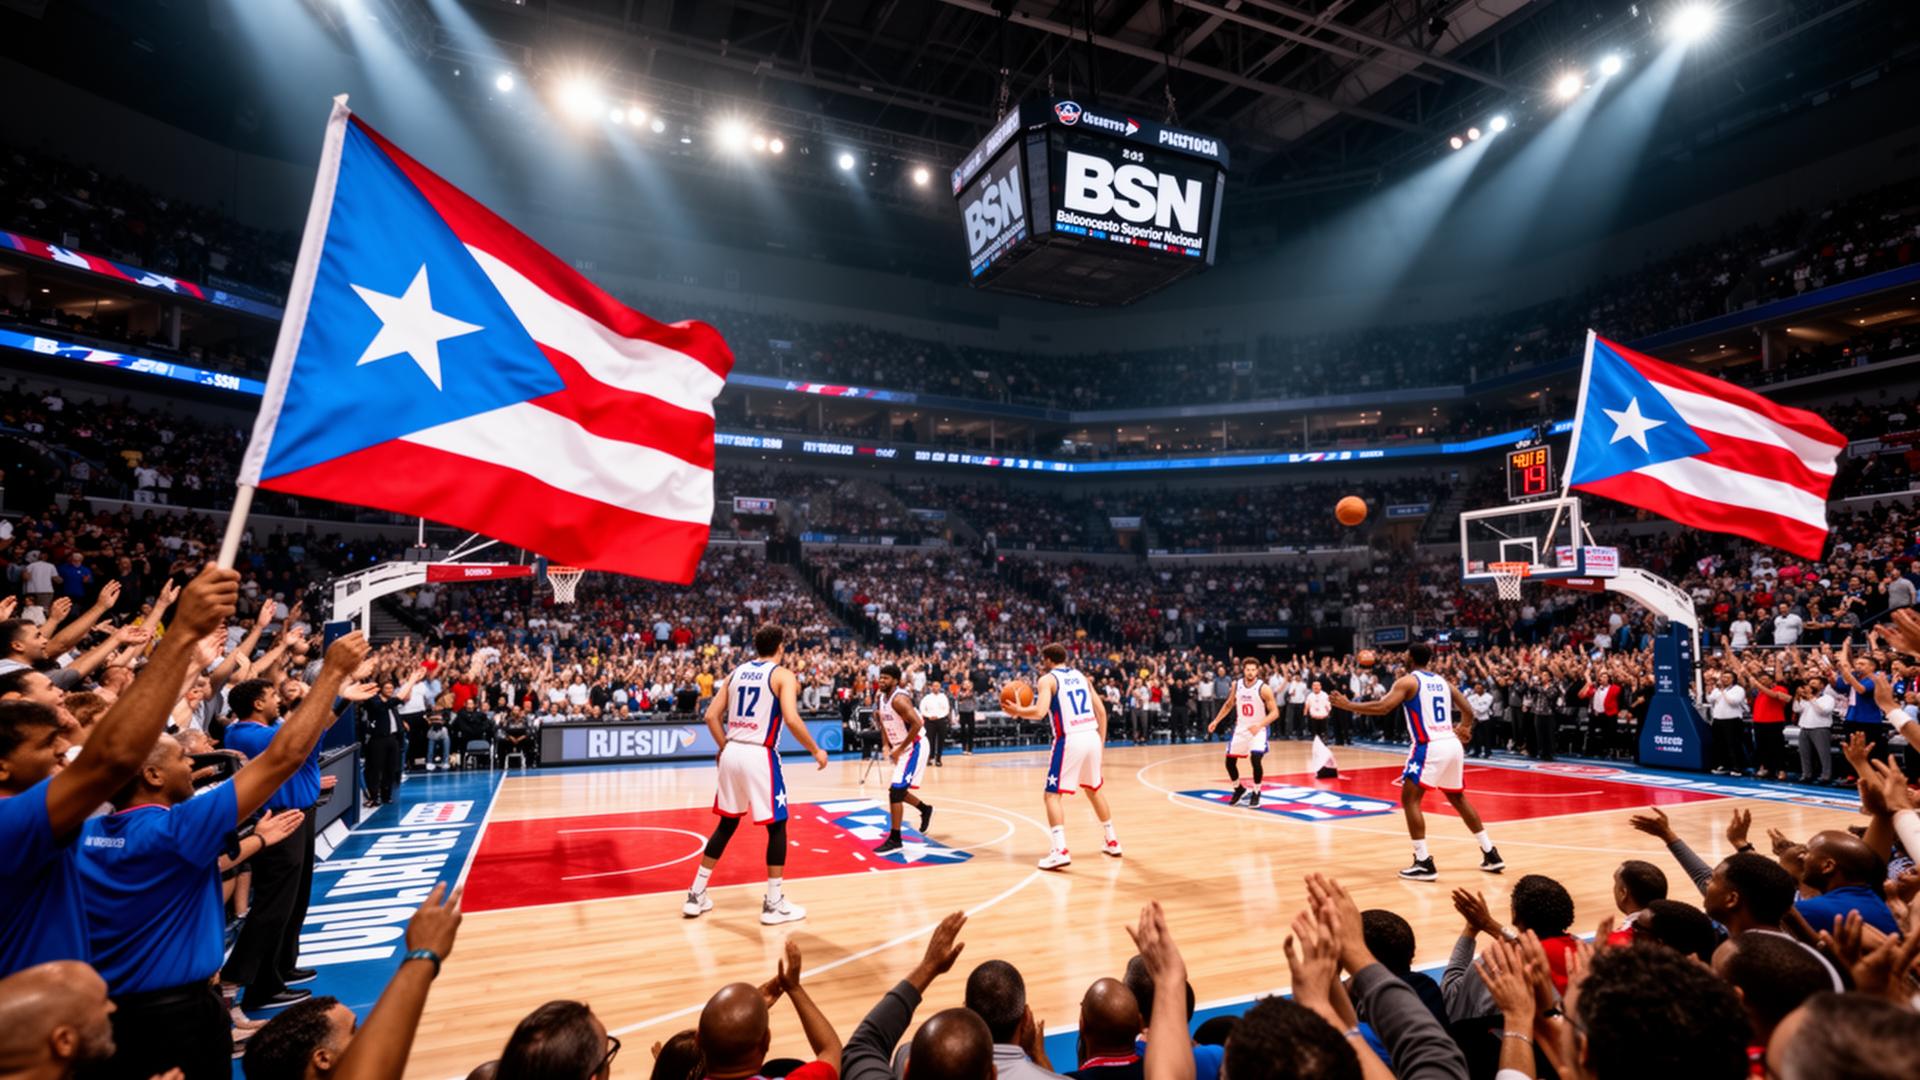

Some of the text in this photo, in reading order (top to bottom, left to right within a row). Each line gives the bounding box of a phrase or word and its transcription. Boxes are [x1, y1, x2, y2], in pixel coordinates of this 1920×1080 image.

[1064, 150, 1202, 233] BSN
[964, 164, 1024, 256] BSN
[1121, 222, 1164, 241] Superior
[737, 685, 761, 717] 12
[1067, 688, 1091, 716] 12
[1432, 695, 1446, 723] 6
